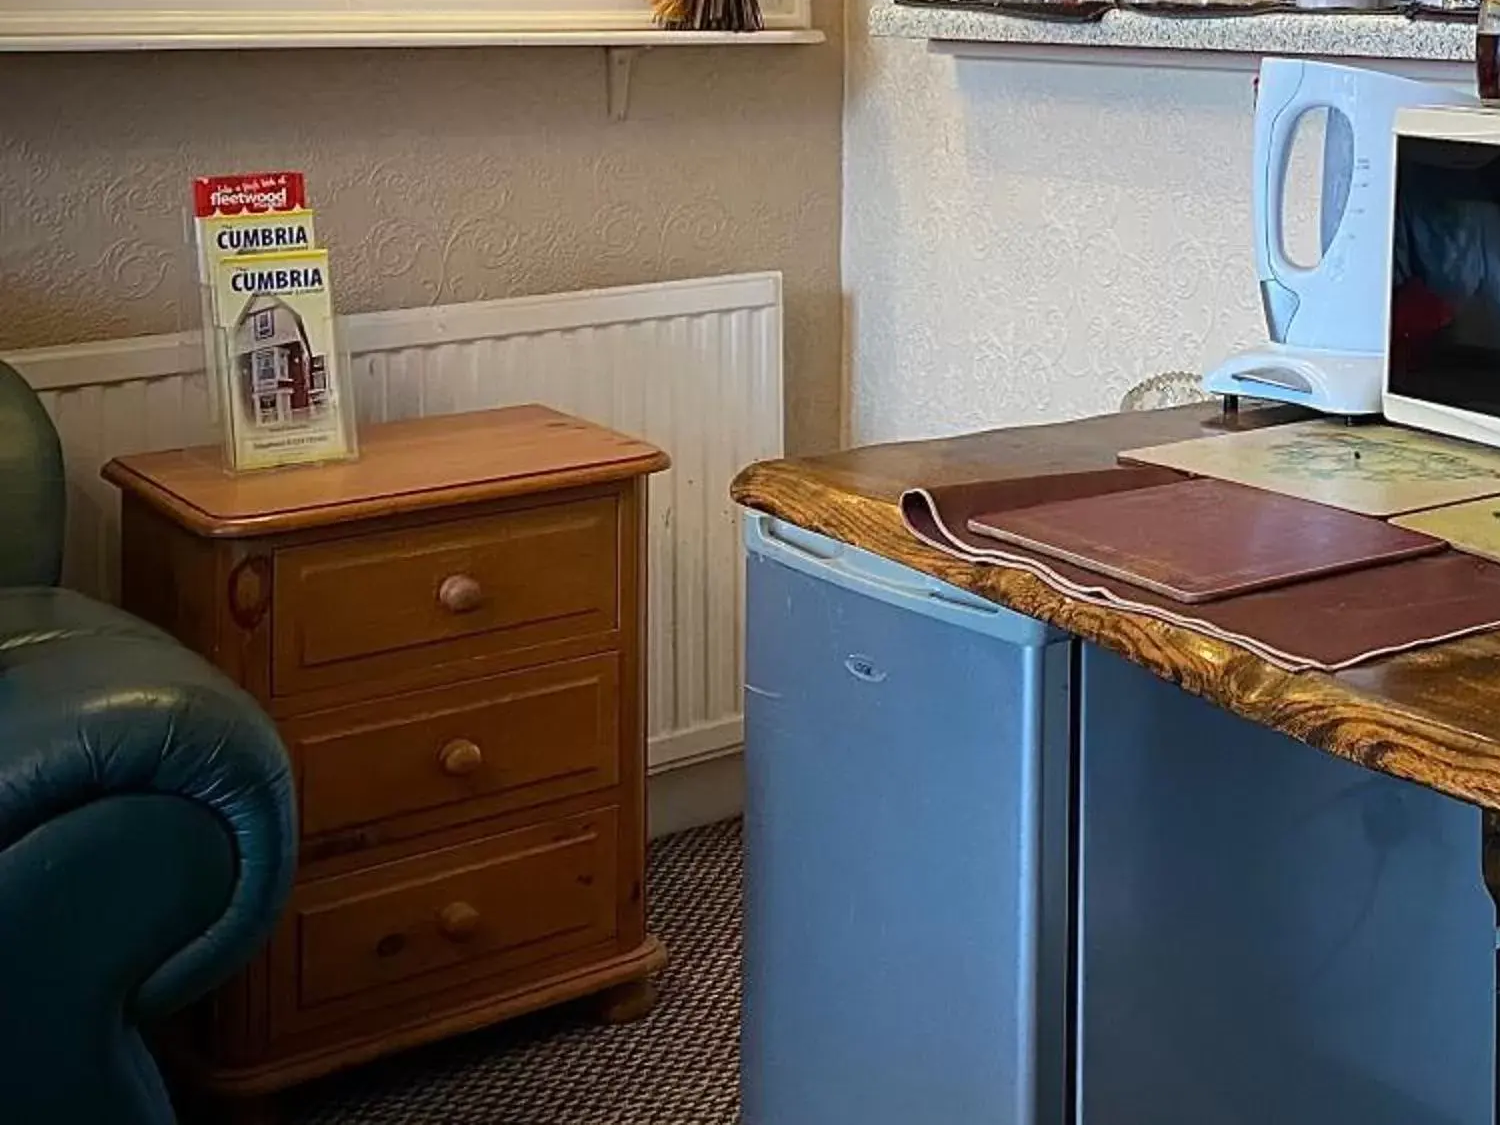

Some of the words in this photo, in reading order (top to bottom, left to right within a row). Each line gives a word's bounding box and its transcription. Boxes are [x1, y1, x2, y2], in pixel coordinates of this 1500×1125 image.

[210, 187, 287, 205] fleetwood
[217, 226, 308, 249] CUMBRIA
[231, 268, 322, 291] CUMBRIA
